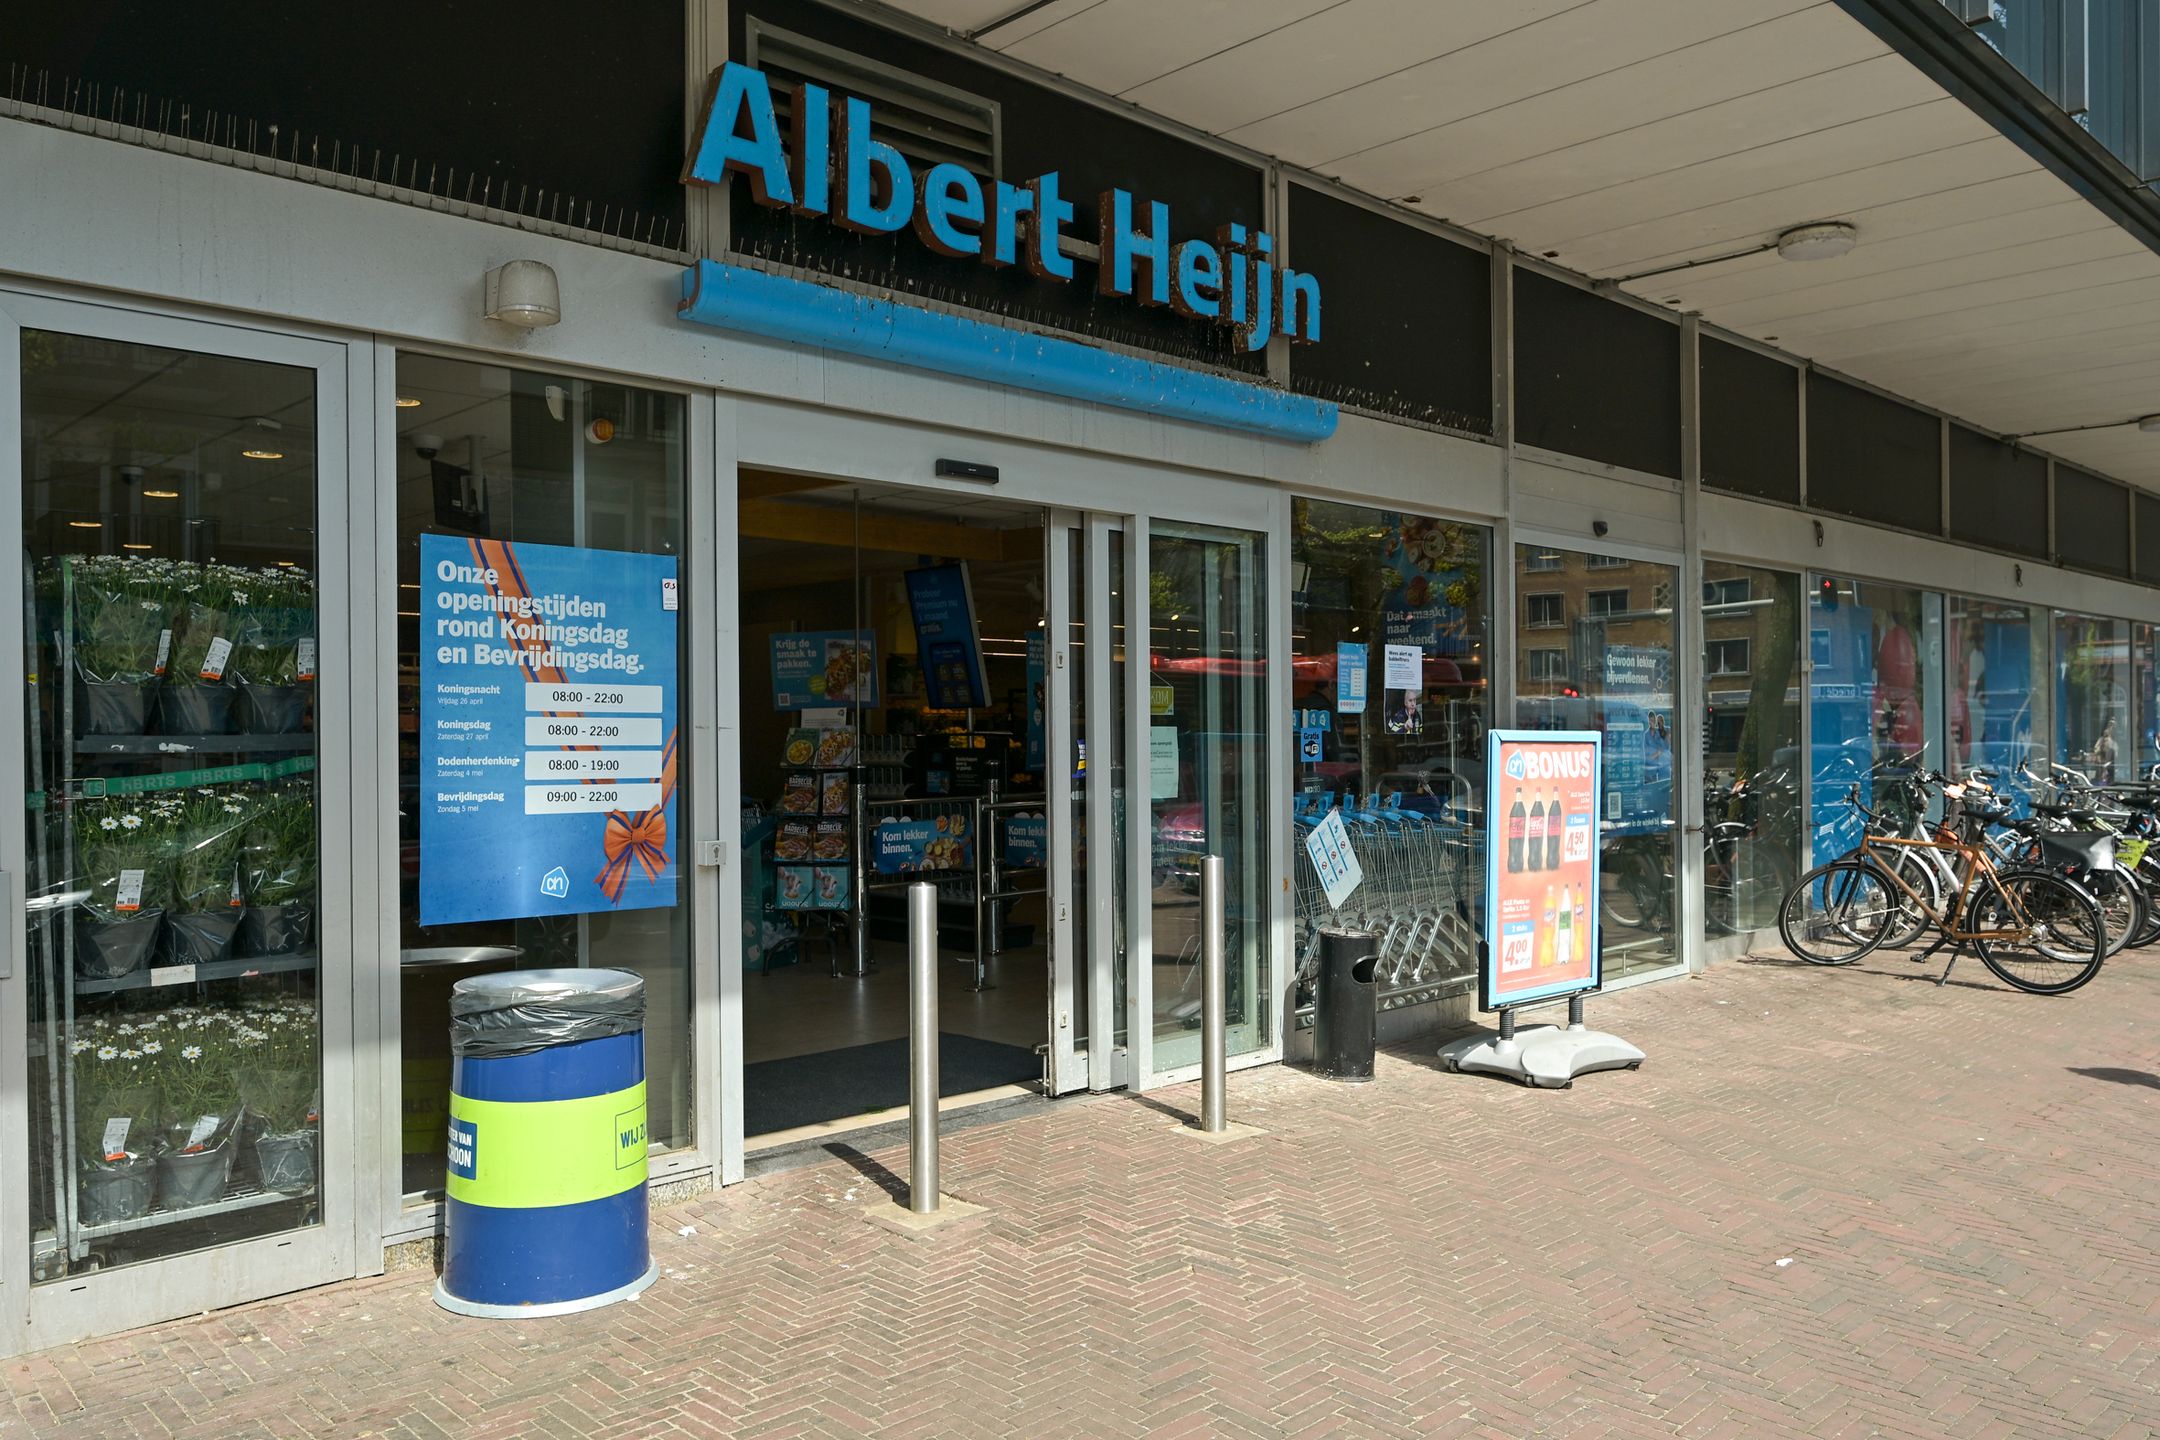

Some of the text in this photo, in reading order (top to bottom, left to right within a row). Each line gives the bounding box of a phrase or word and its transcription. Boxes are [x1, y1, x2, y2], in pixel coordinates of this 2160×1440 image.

[679, 60, 1322, 354] Albert Heijn
[437, 560, 499, 585] Onze
[437, 590, 606, 620] openingstijden
[437, 616, 628, 649] rond Koningsdag
[1387, 624, 1411, 634] naar
[775, 638, 810, 650] Krijg de
[437, 643, 645, 675] en Bevrijdingsdag.
[776, 648, 817, 659] smaak te
[777, 659, 812, 669] pakken.
[1607, 654, 1657, 668] Gewoon lekker
[1606, 670, 1650, 686] bijverdienen.
[437, 684, 501, 695] Koningsnacht
[437, 697, 459, 707] Vrijdag
[469, 697, 484, 706] april
[552, 691, 583, 702] 08:00
[594, 692, 624, 704] 22:00
[437, 719, 492, 731] Koningsdag
[548, 724, 578, 736] 08:00
[589, 725, 619, 737] 22:00
[437, 733, 465, 741] Zaterdag
[475, 732, 490, 741] april
[1303, 732, 1320, 740] Gratis
[548, 759, 579, 771] 08:00
[590, 759, 619, 771] 19:00
[1524, 750, 1591, 779] BONUS
[437, 769, 465, 778] Zaterdag
[471, 769, 484, 777] mei
[437, 791, 505, 803] Bevrijdingsdag
[547, 791, 577, 802] 09:00
[588, 791, 618, 802] 22:00
[437, 805, 460, 813] Zondag
[467, 804, 479, 812] mei
[882, 829, 929, 842] Kom lekker
[1008, 825, 1027, 836] Kom
[1008, 837, 1038, 848] binnen.
[882, 843, 913, 855] binnen.
[459, 1131, 472, 1147] VAN
[620, 1126, 639, 1149] WIJ
